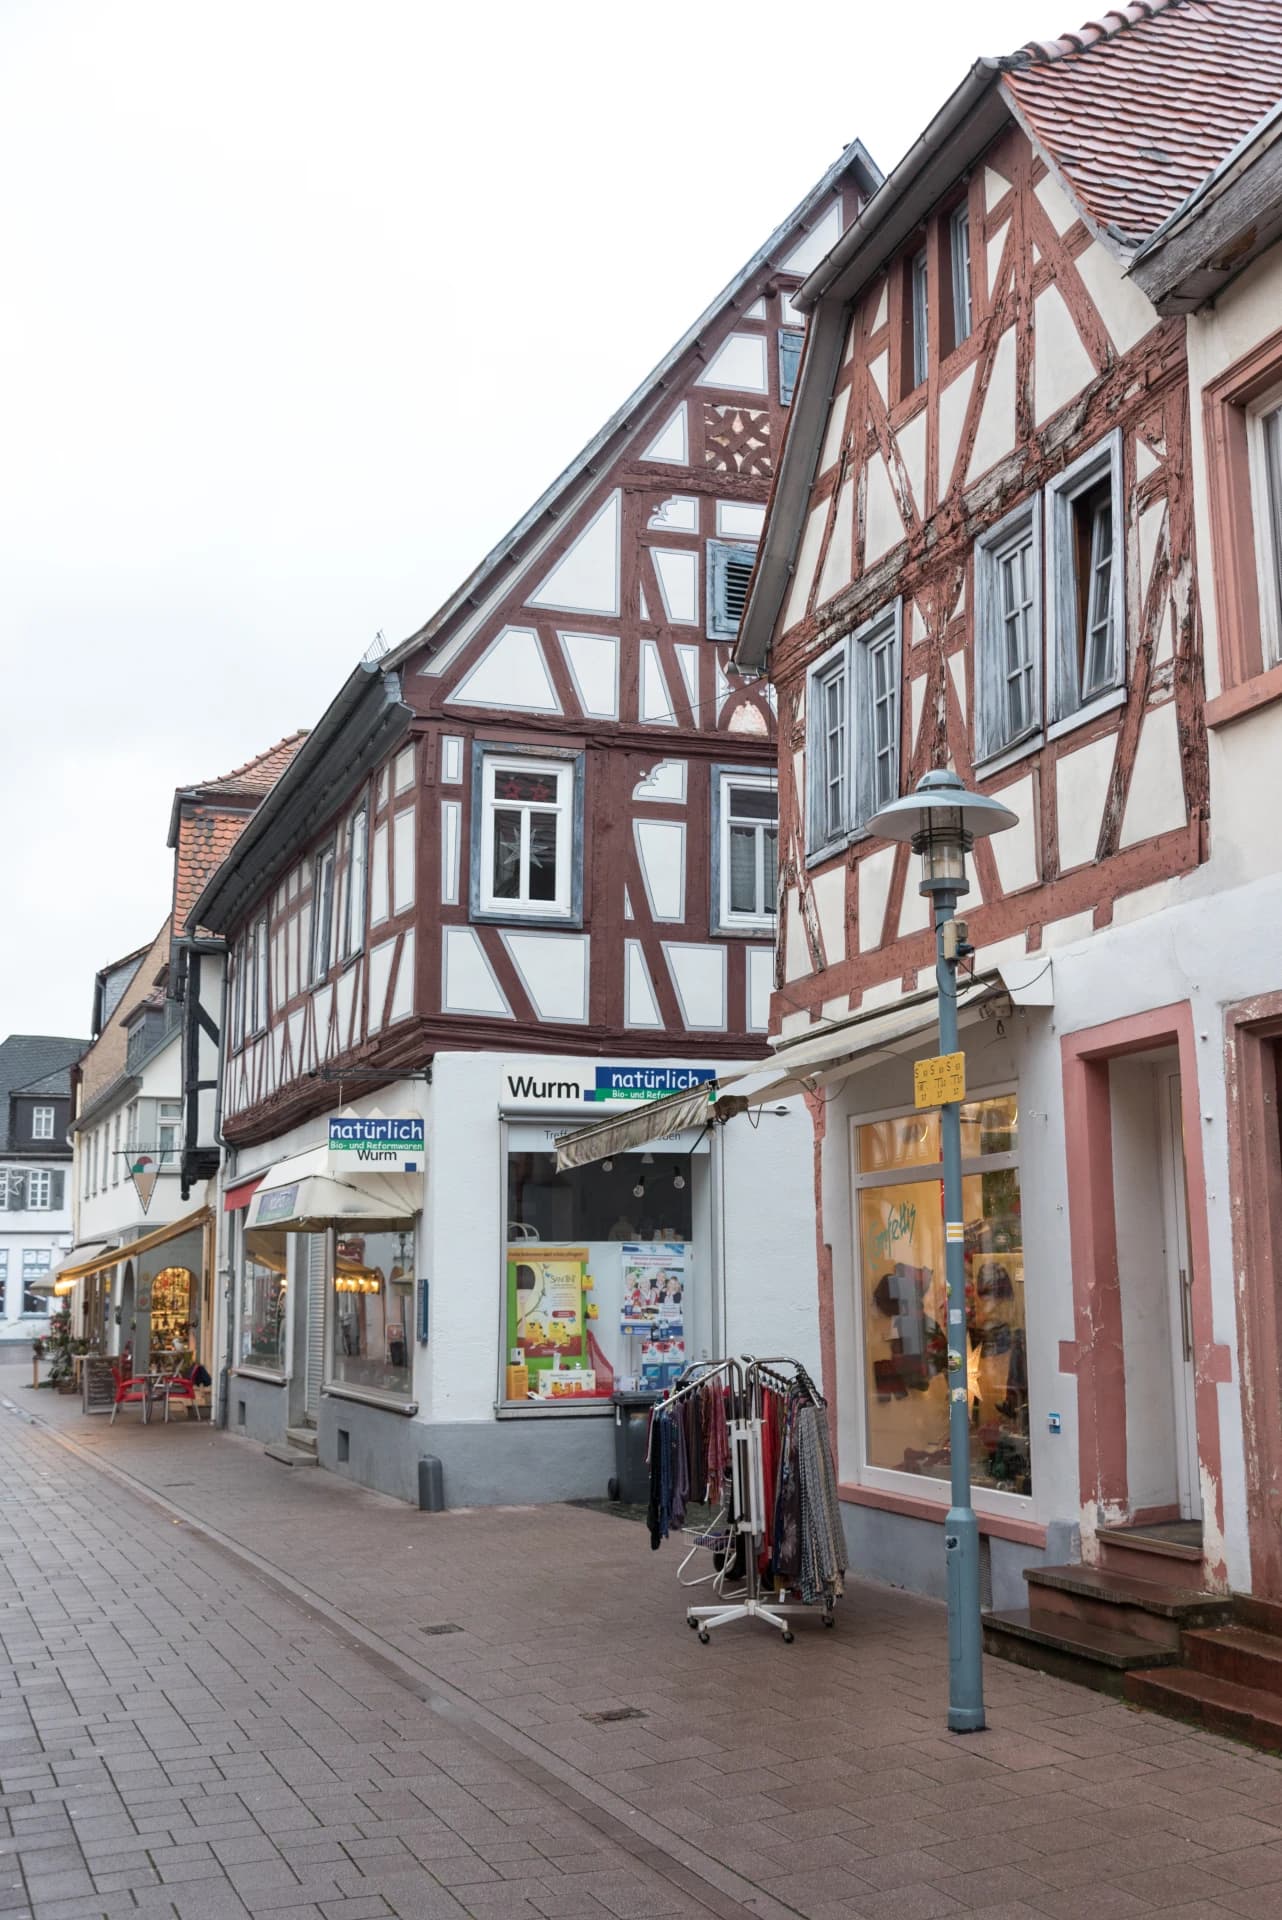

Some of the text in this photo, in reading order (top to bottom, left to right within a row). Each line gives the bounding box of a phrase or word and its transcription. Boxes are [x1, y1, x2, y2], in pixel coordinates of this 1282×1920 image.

[507, 1075, 580, 1099] Wurm
[611, 1070, 700, 1090] natürlich
[612, 1089, 628, 1099] Bio-
[630, 1090, 645, 1099] und
[330, 1120, 422, 1139] natürlich
[330, 1140, 423, 1150] Bio- und Reformwaren
[357, 1150, 397, 1160] Wurm
